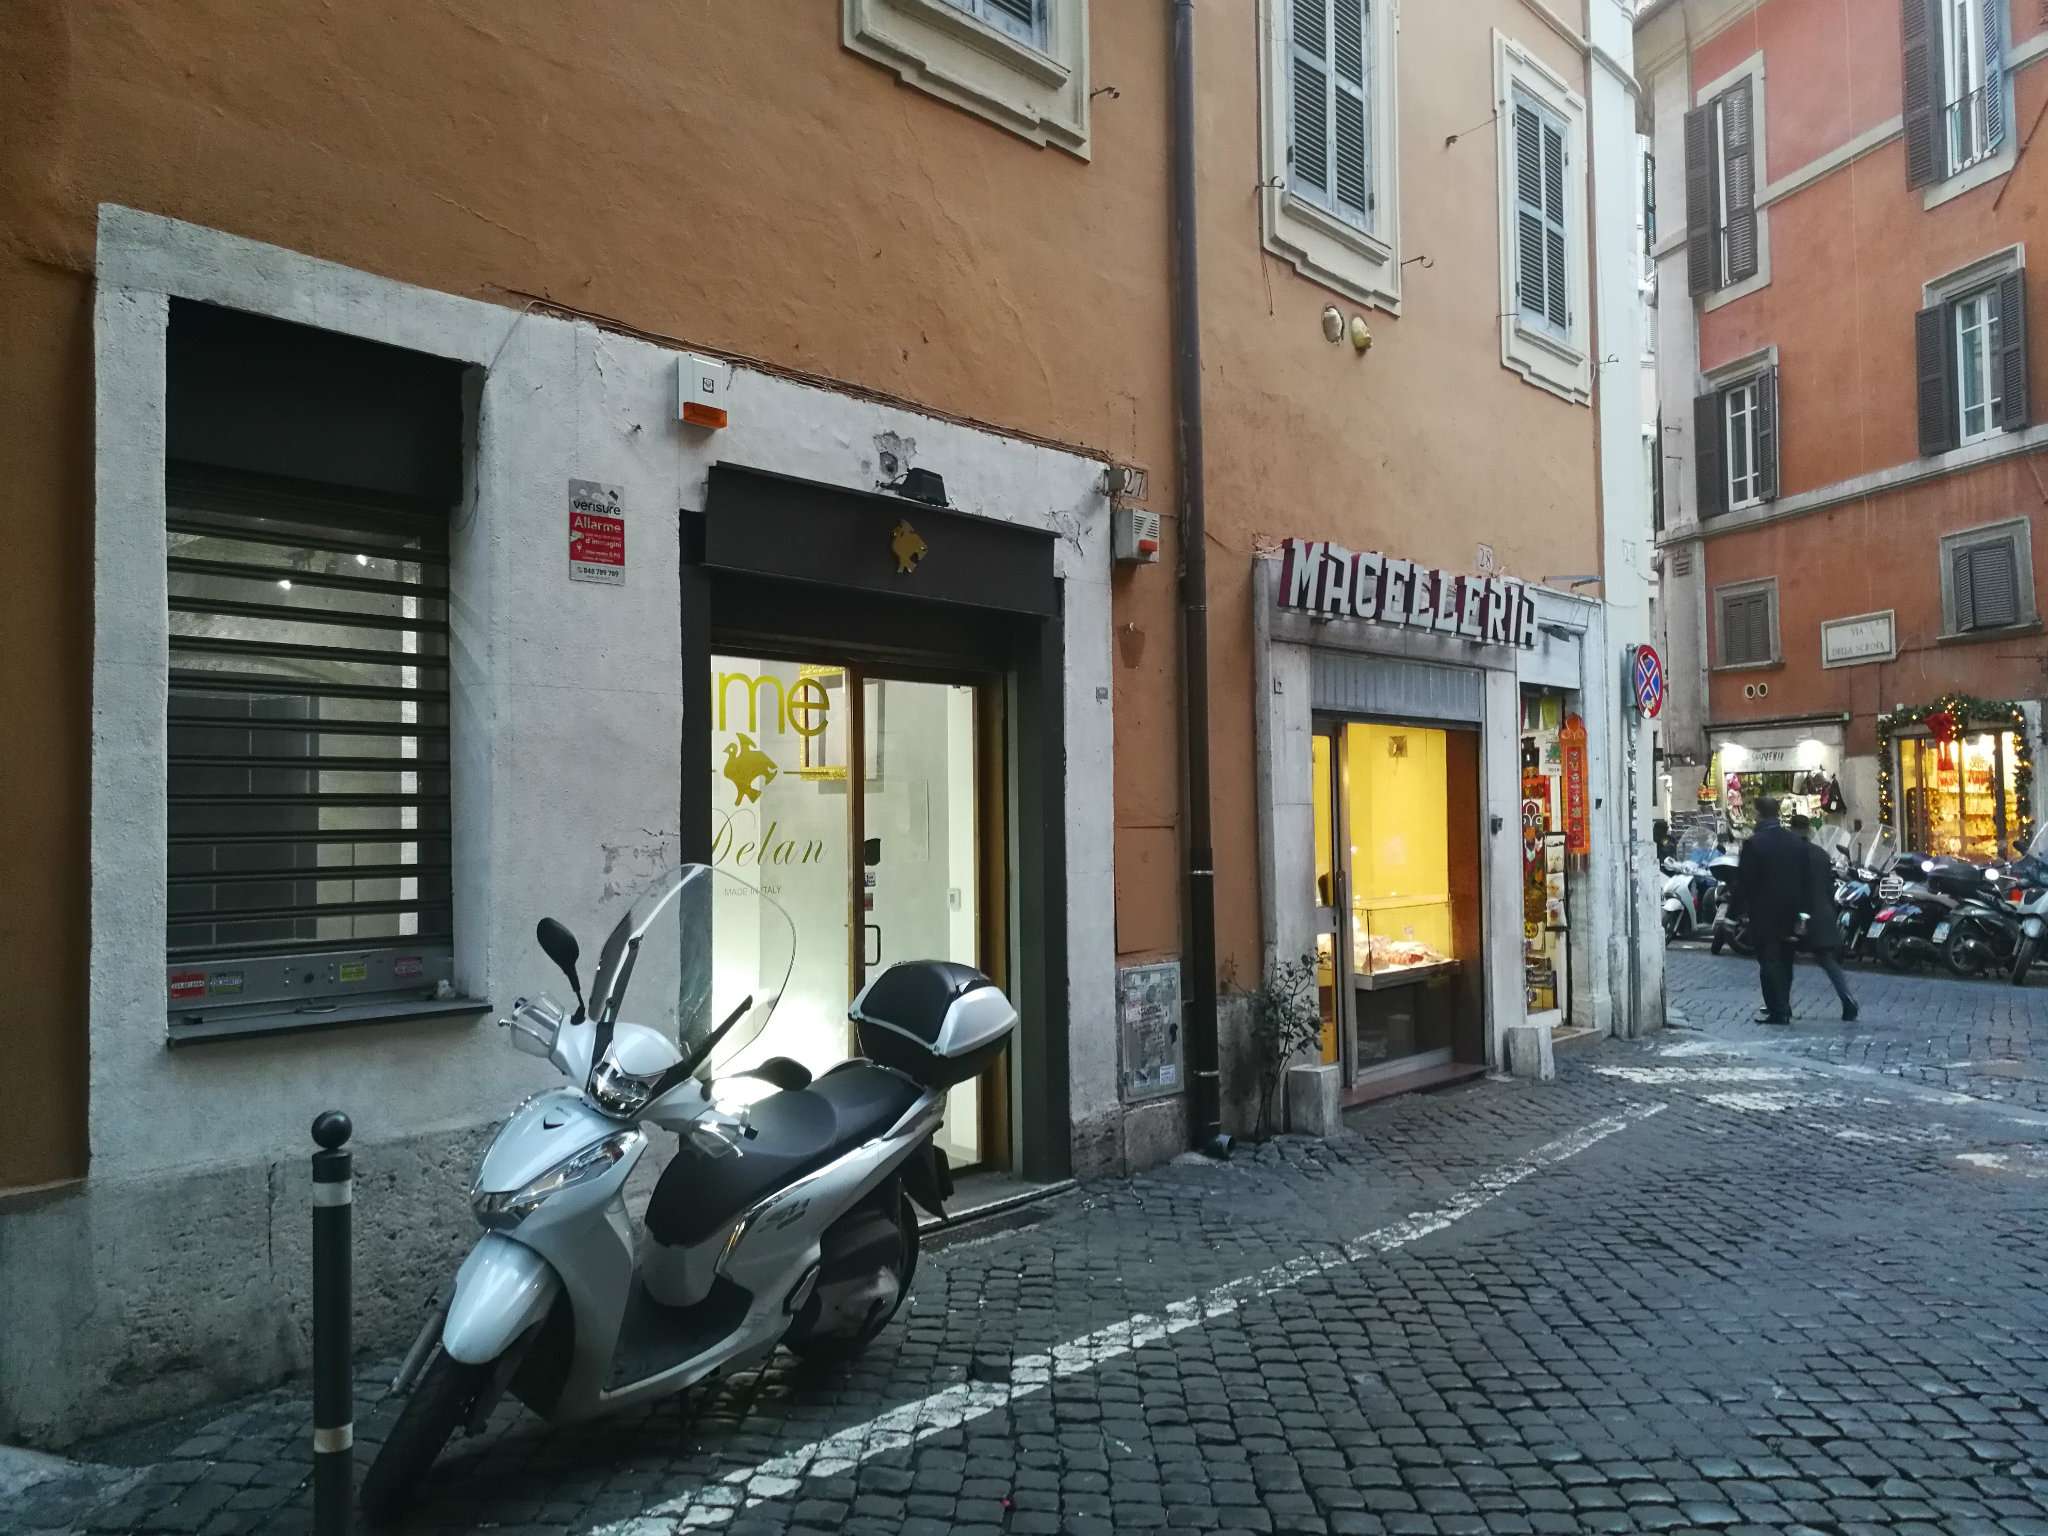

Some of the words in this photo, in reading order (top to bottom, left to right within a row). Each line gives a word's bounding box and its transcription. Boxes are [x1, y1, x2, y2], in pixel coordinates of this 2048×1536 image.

[1124, 467, 1145, 497] 27
[573, 500, 621, 515] verisure
[574, 515, 622, 533] Allarme
[1282, 537, 1538, 646] MACELLERIA
[711, 671, 830, 737] me
[711, 808, 827, 867] Delan
[724, 887, 748, 897] MADE
[760, 885, 782, 896] ITALY
